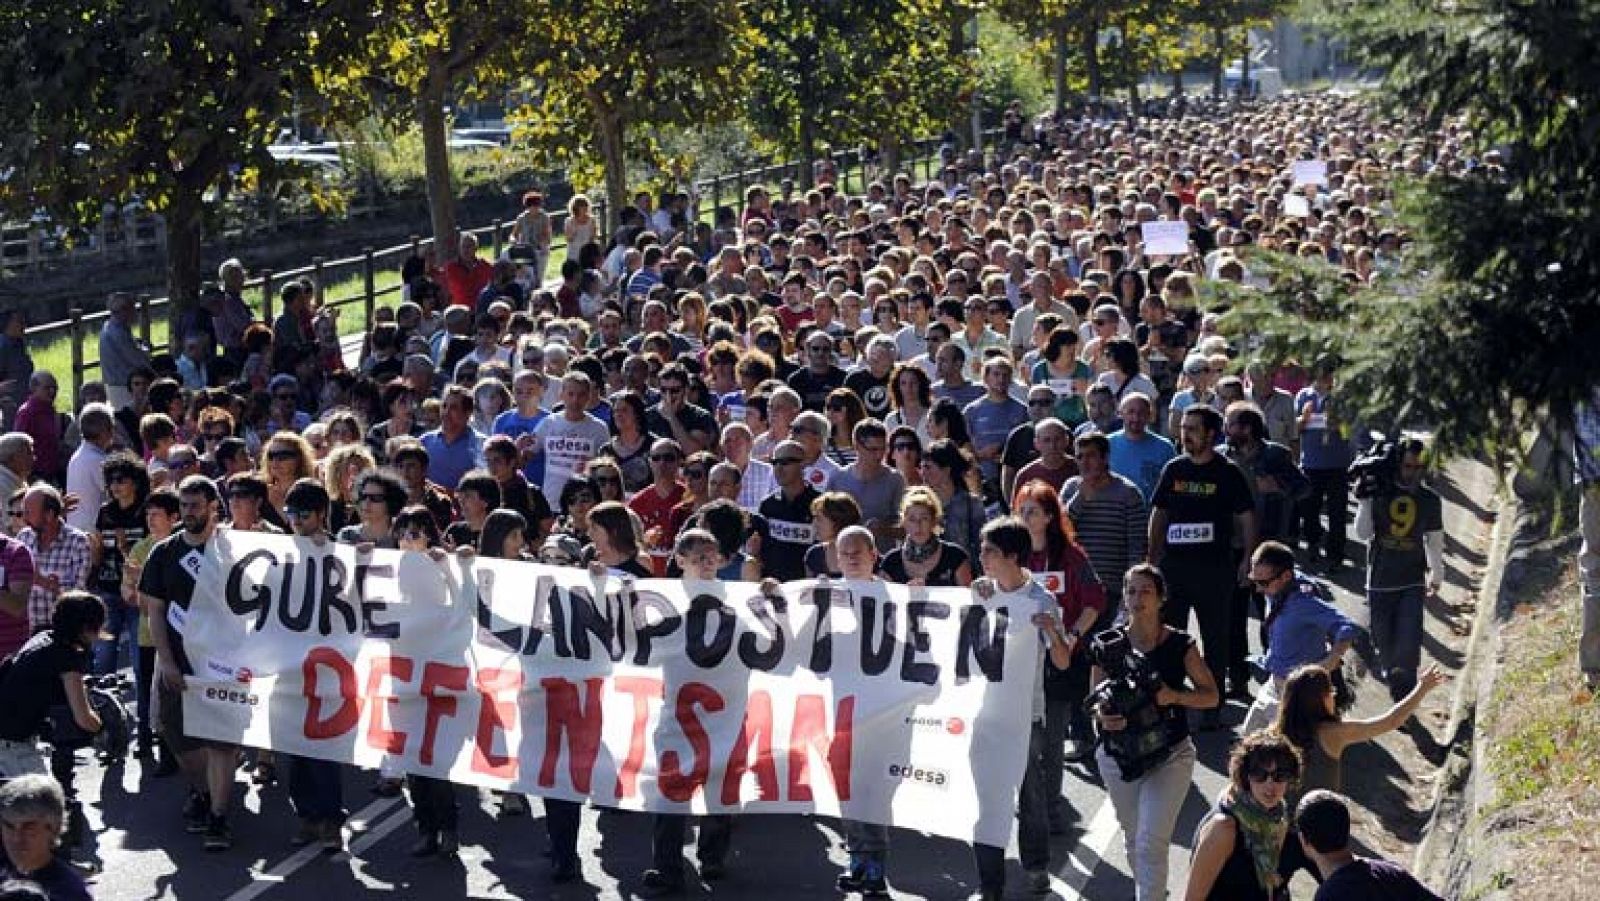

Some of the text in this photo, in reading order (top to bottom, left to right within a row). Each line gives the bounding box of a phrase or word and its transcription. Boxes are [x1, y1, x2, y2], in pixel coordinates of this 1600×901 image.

[1389, 496, 1416, 537] 9
[225, 550, 1008, 685] GURE LANPOSTUEN
[303, 646, 856, 807] DEFENTSAN
[889, 764, 946, 785] edesa
